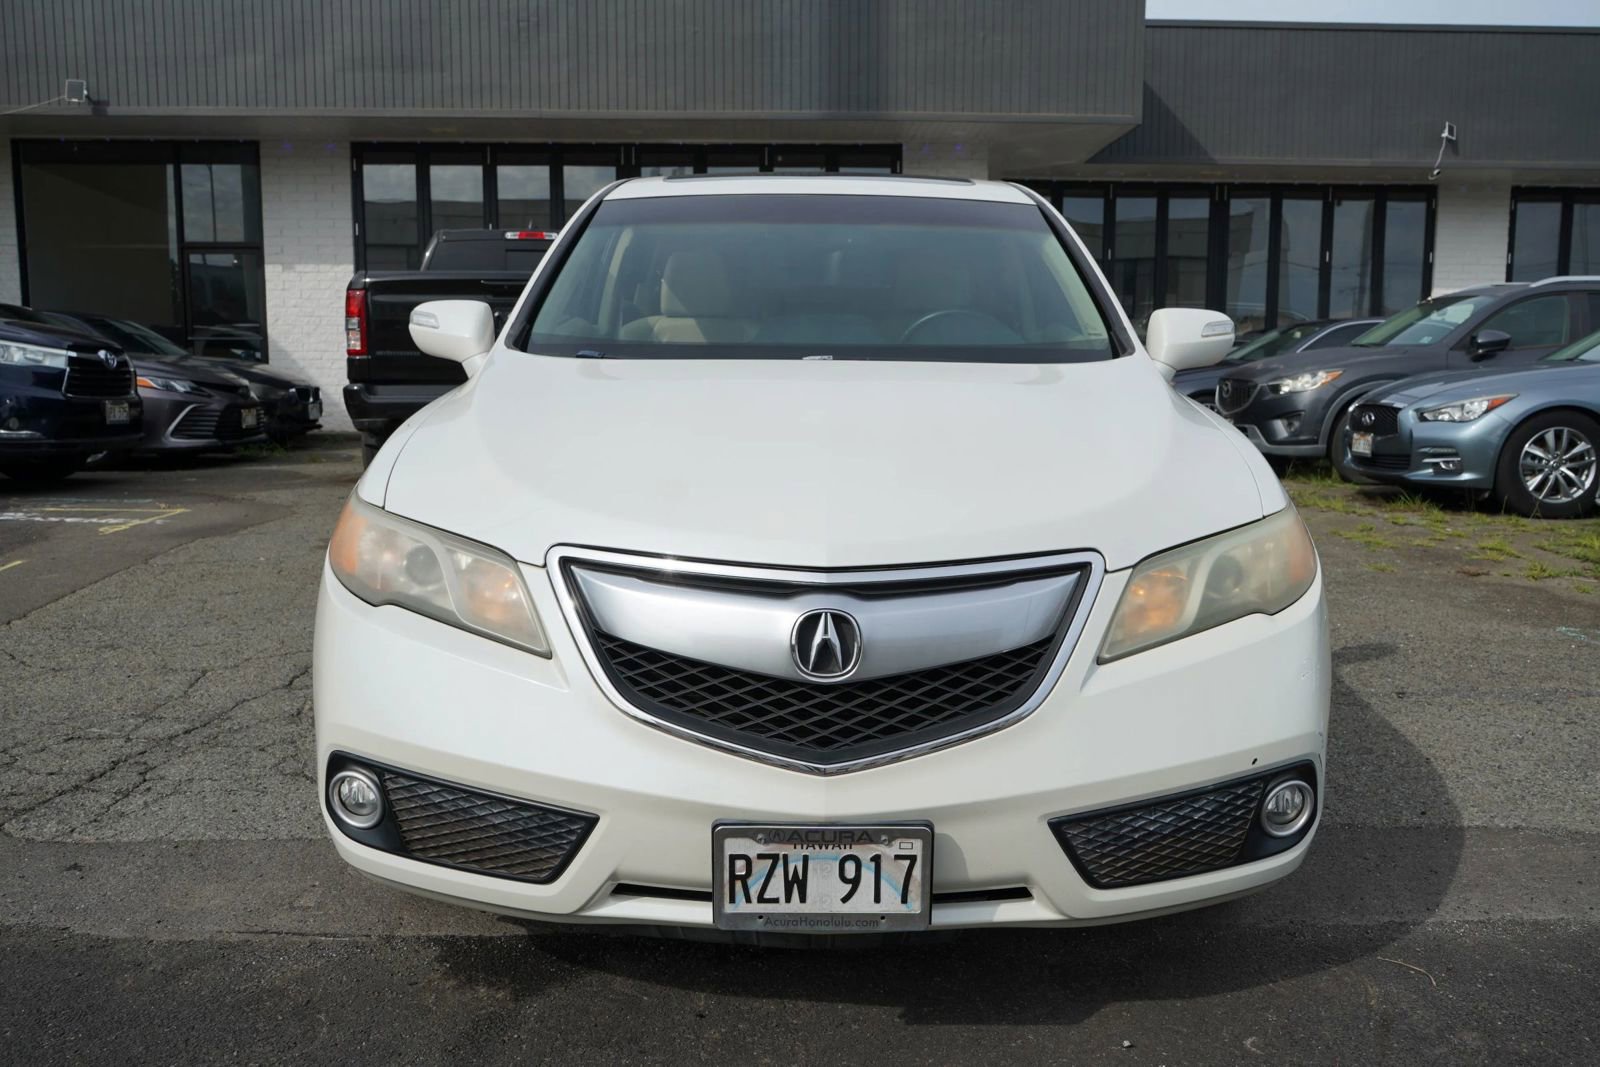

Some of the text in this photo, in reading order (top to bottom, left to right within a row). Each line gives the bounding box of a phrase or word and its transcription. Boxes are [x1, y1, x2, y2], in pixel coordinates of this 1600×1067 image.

[788, 830, 874, 843] ACURA
[728, 853, 918, 904] RZW 917
[764, 916, 879, 928] AcuraHonolulu.com
